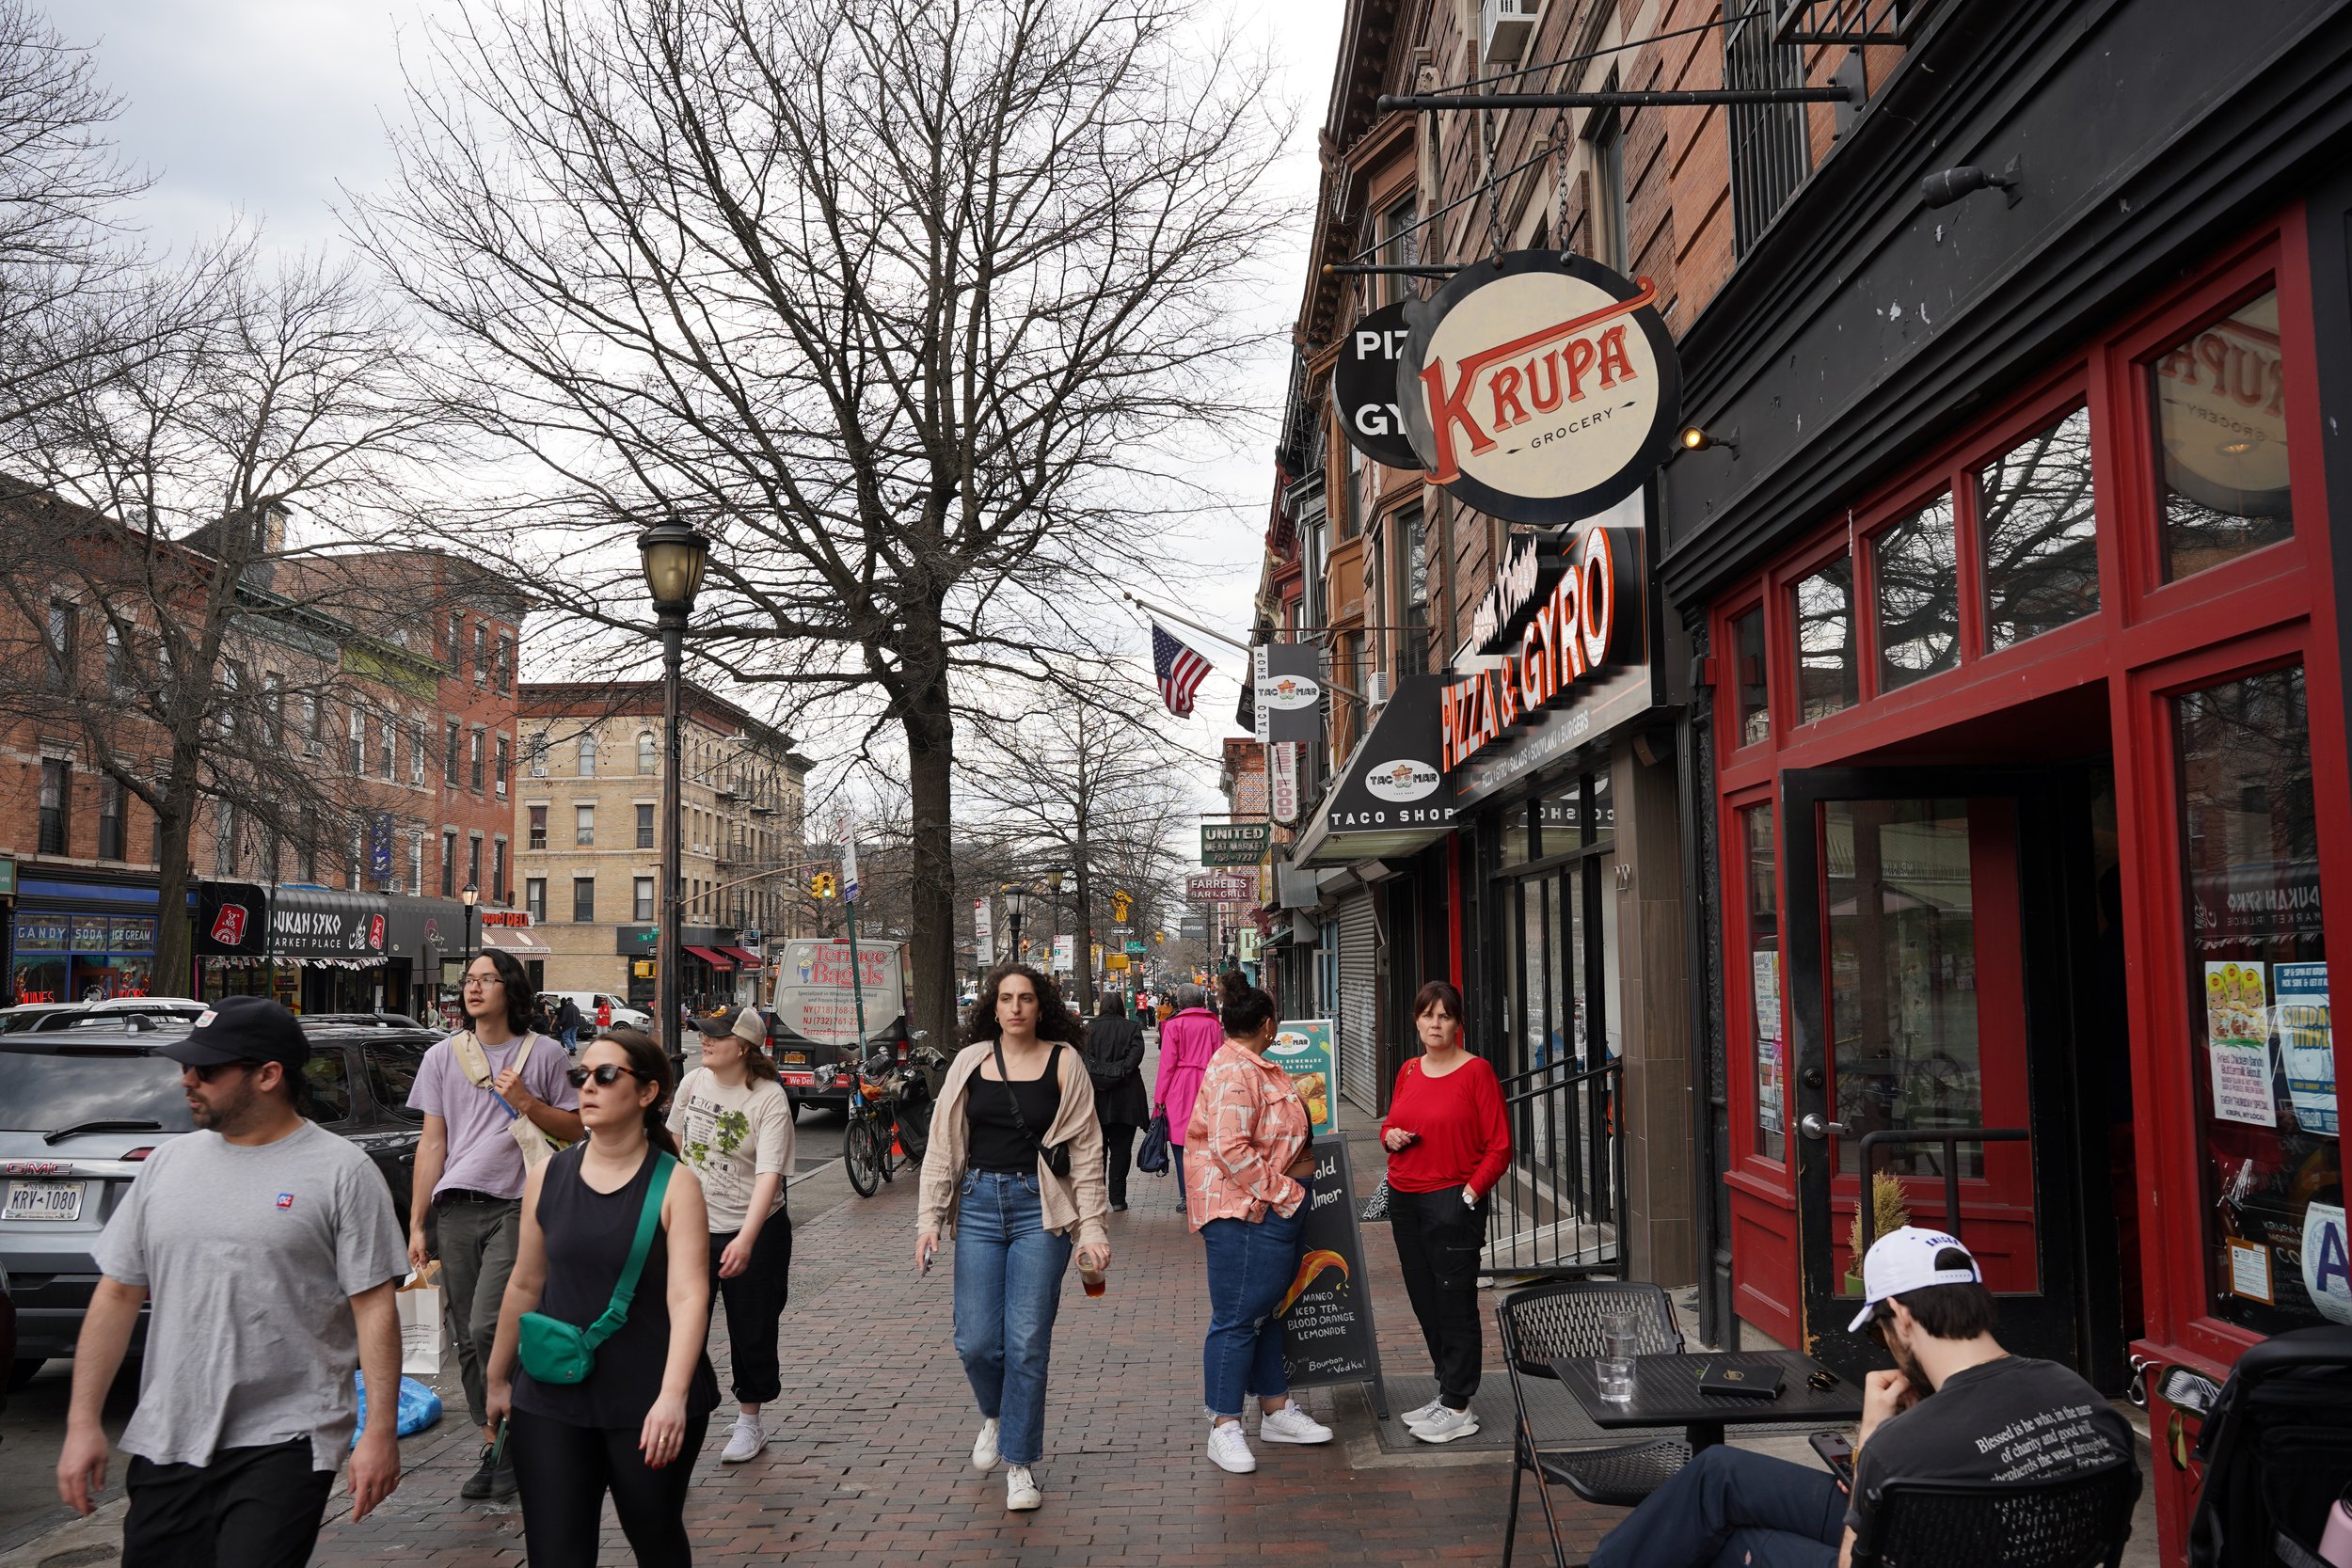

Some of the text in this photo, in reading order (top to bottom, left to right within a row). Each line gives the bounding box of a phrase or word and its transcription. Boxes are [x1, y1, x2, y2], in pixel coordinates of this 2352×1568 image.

[1419, 315, 1641, 484] KRUPA
[1355, 404, 1407, 436] GY
[1531, 406, 1613, 449] GROCERY
[1441, 668, 1500, 774] PIZZA
[1501, 656, 1518, 728] &
[1520, 527, 1615, 712] GYRO
[1257, 651, 1267, 680] SHOP
[1295, 688, 1317, 696] MAR
[1257, 705, 1267, 735] TACO
[1510, 745, 1528, 773] SALADS
[1561, 709, 1589, 743] BURGERS
[1413, 772, 1438, 784] MAR
[1277, 780, 1294, 816] FOOD
[1331, 807, 1454, 826] TACO SHOP
[1205, 827, 1264, 841] UNITED
[1204, 841, 1265, 852] MEAT MARKET
[1215, 869, 1222, 878] F
[1191, 879, 1248, 889] FARRELL'S
[1191, 889, 1211, 898] BAR
[1221, 889, 1248, 898] GRILL
[312, 912, 342, 935] SYKO
[506, 912, 528, 927] DELI
[75, 928, 103, 940] SODA
[311, 939, 342, 948] PLACE
[813, 943, 887, 964] Terrace
[814, 1006, 834, 1015] (718)
[2282, 1007, 2330, 1027] SUNDA
[813, 1017, 833, 1026] (732)
[803, 1027, 860, 1038] TerraceBagels.co
[7, 1162, 72, 1176] GMC
[11, 1191, 76, 1211] KRV 1080
[2263, 1221, 2296, 1233] KRUPA
[2316, 1221, 2352, 1295] A
[1302, 1291, 1333, 1304] MANGO
[1295, 1304, 1338, 1316] ICED TEA
[1287, 1312, 1355, 1331] BLOOD ORANGE
[1297, 1325, 1346, 1340] LEMONADE
[1309, 1356, 1343, 1371] Bourbon
[1976, 1404, 2092, 1454] Blessed is he who, in the name
[2000, 1446, 2013, 1464] of
[2012, 1436, 2042, 1458] charity
[2041, 1428, 2058, 1446] and
[2057, 1423, 2079, 1444] good
[2037, 1452, 2054, 1468] the
[2051, 1444, 2074, 1461] weak
